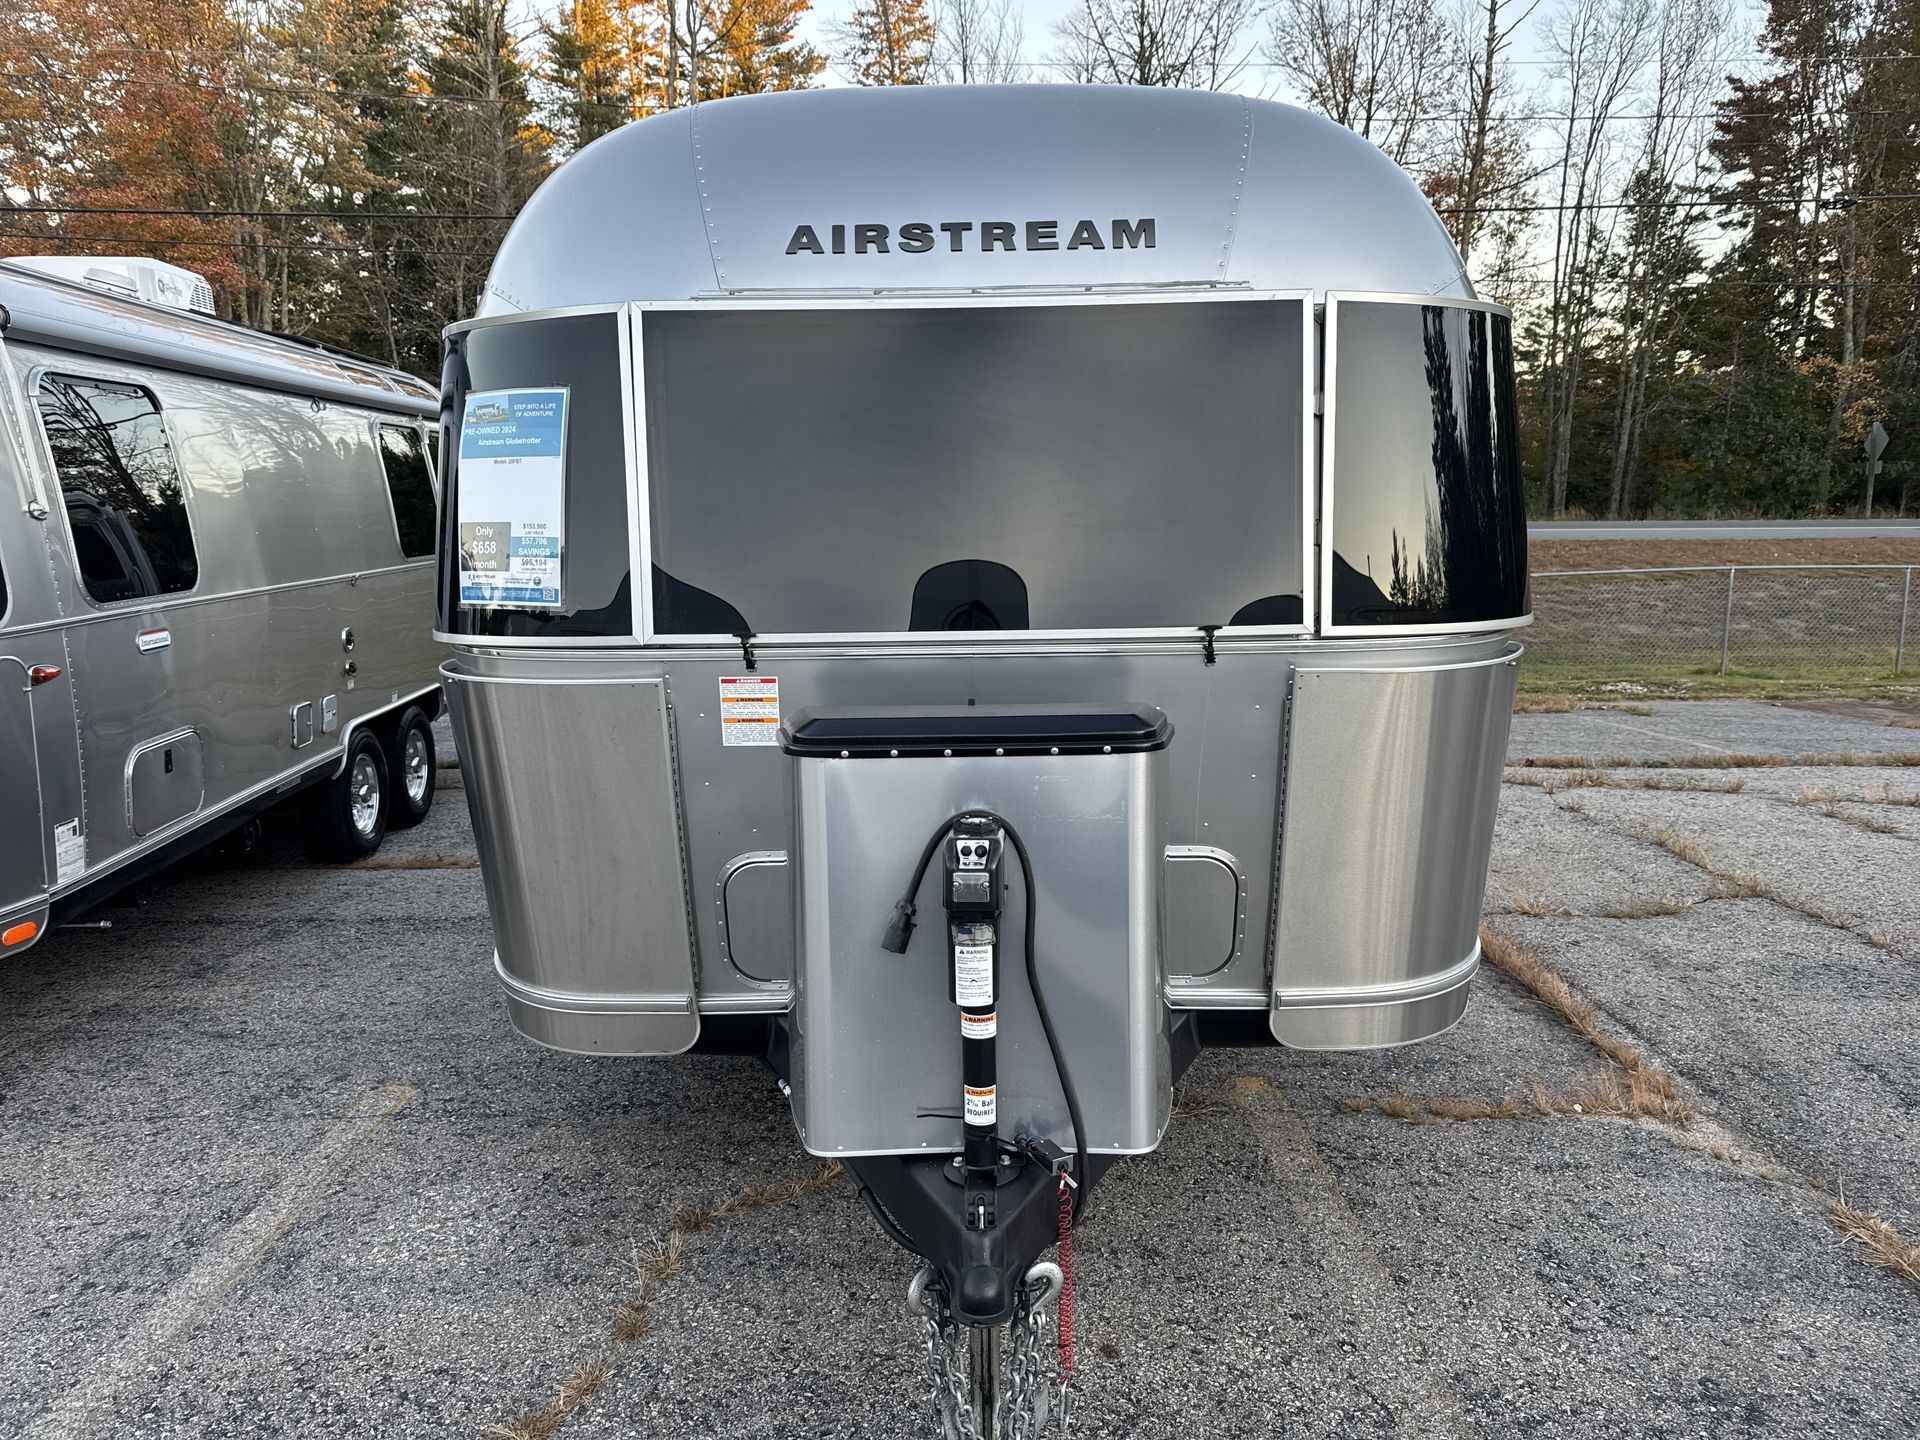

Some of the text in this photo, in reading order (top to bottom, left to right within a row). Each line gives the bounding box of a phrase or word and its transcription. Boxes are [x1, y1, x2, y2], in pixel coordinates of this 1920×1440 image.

[785, 218, 1156, 255] AIRSTREAM
[464, 425, 516, 436] PRE-OWNED 2024
[506, 437, 541, 445] Globetrotter
[475, 526, 494, 538] Only
[472, 540, 497, 555] $658
[518, 548, 551, 556] SAVINGS
[968, 1015, 995, 1023] WARNING
[967, 1108, 994, 1116] REQUIRED
